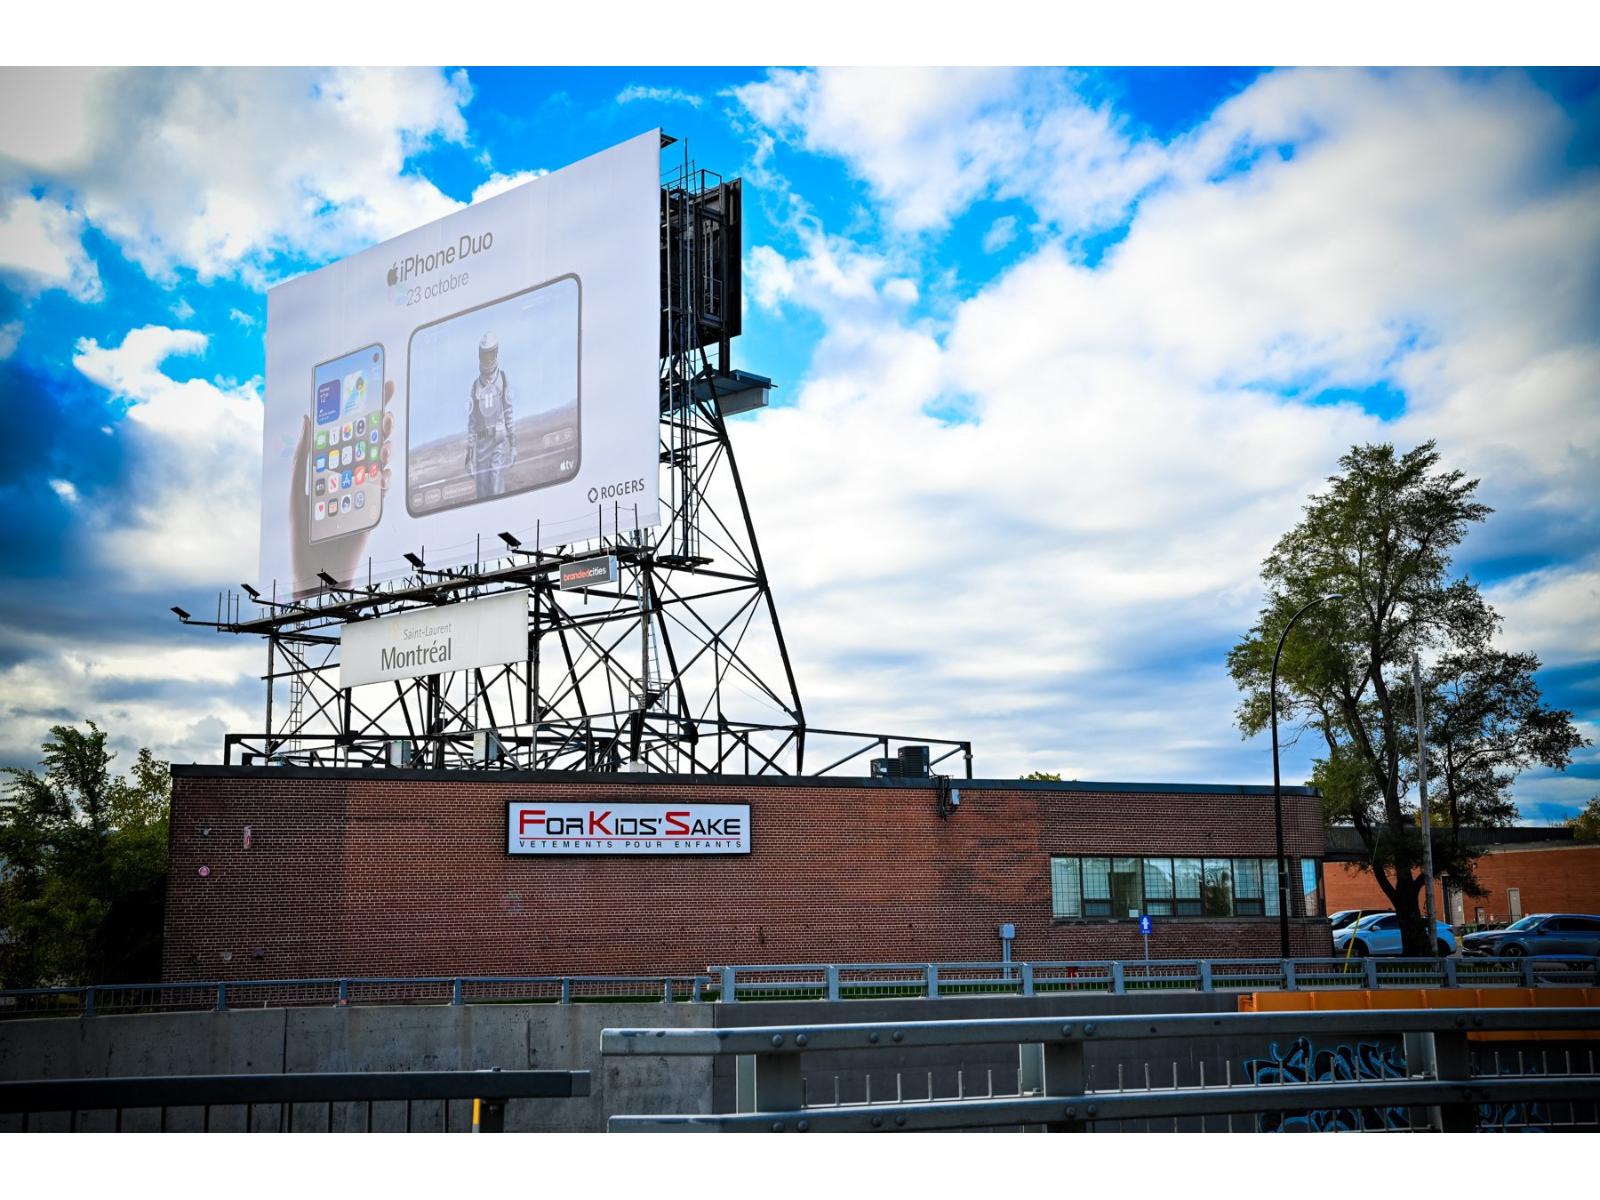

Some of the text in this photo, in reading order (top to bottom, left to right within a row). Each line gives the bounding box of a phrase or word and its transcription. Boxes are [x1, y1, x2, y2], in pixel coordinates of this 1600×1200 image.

[399, 231, 493, 282] iPhone Duo
[406, 272, 469, 307] 23 octobre
[601, 478, 645, 499] ROGERS
[403, 623, 452, 641] Saint-Laurent
[381, 637, 452, 671] Montréal
[519, 840, 742, 849] VETEMENTS POUR ENFANTS
